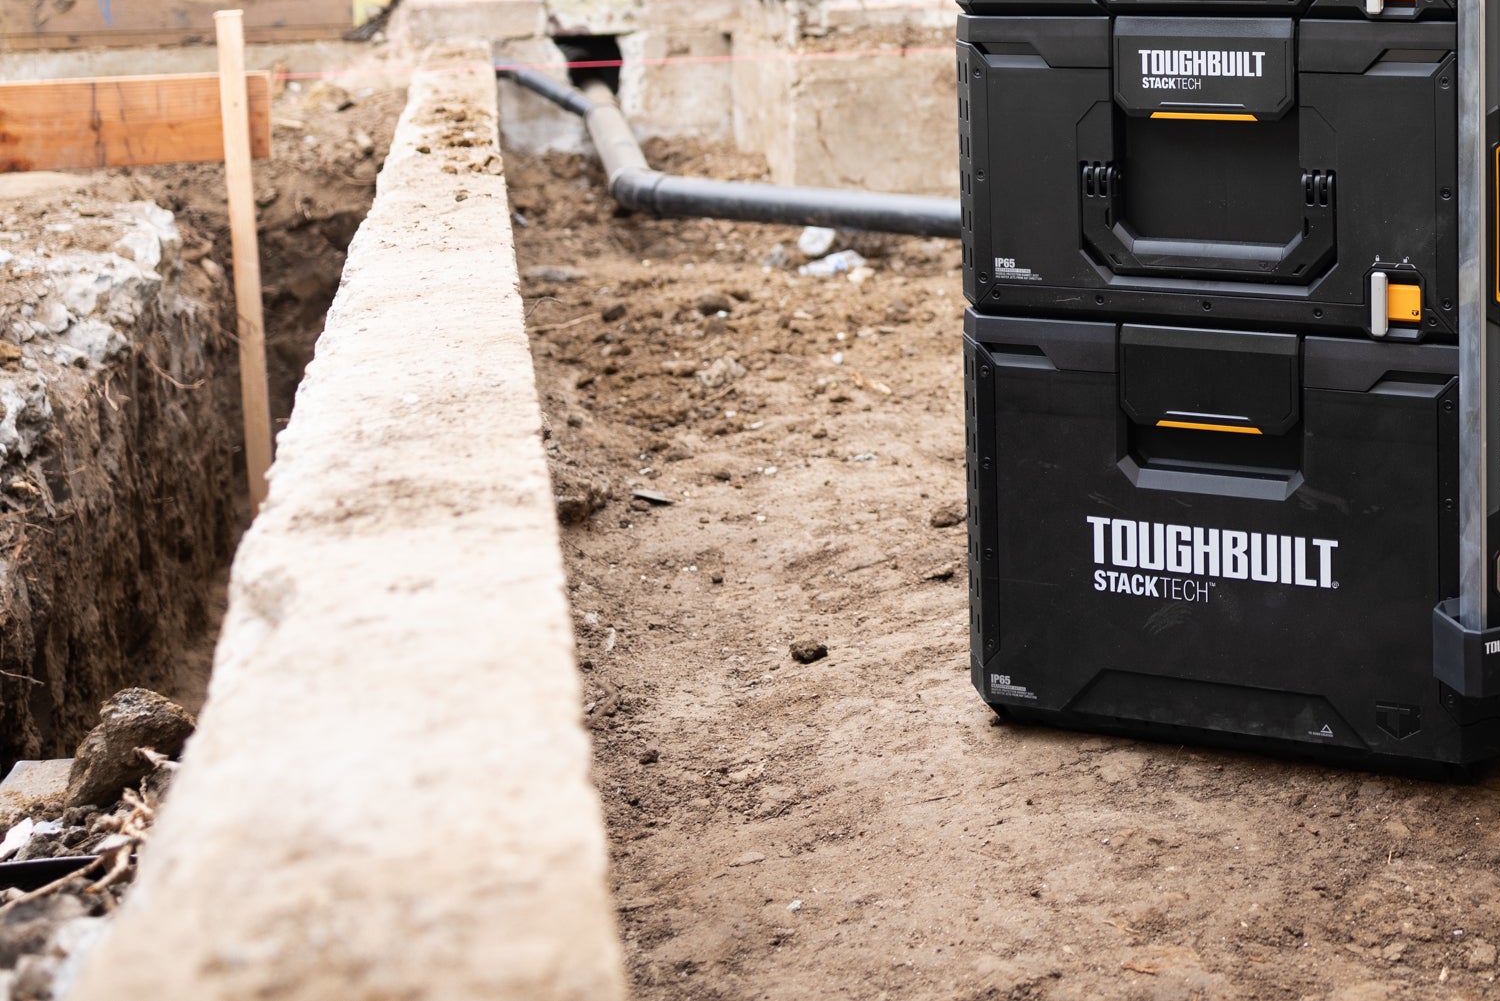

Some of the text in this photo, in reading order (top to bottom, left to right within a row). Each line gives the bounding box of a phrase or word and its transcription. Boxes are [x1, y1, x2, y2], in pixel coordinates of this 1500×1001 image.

[1138, 49, 1266, 77] TOUGHBUILT
[1142, 77, 1202, 90] STACKTECH
[994, 257, 1016, 268] IP65
[990, 673, 1011, 685] IP65
